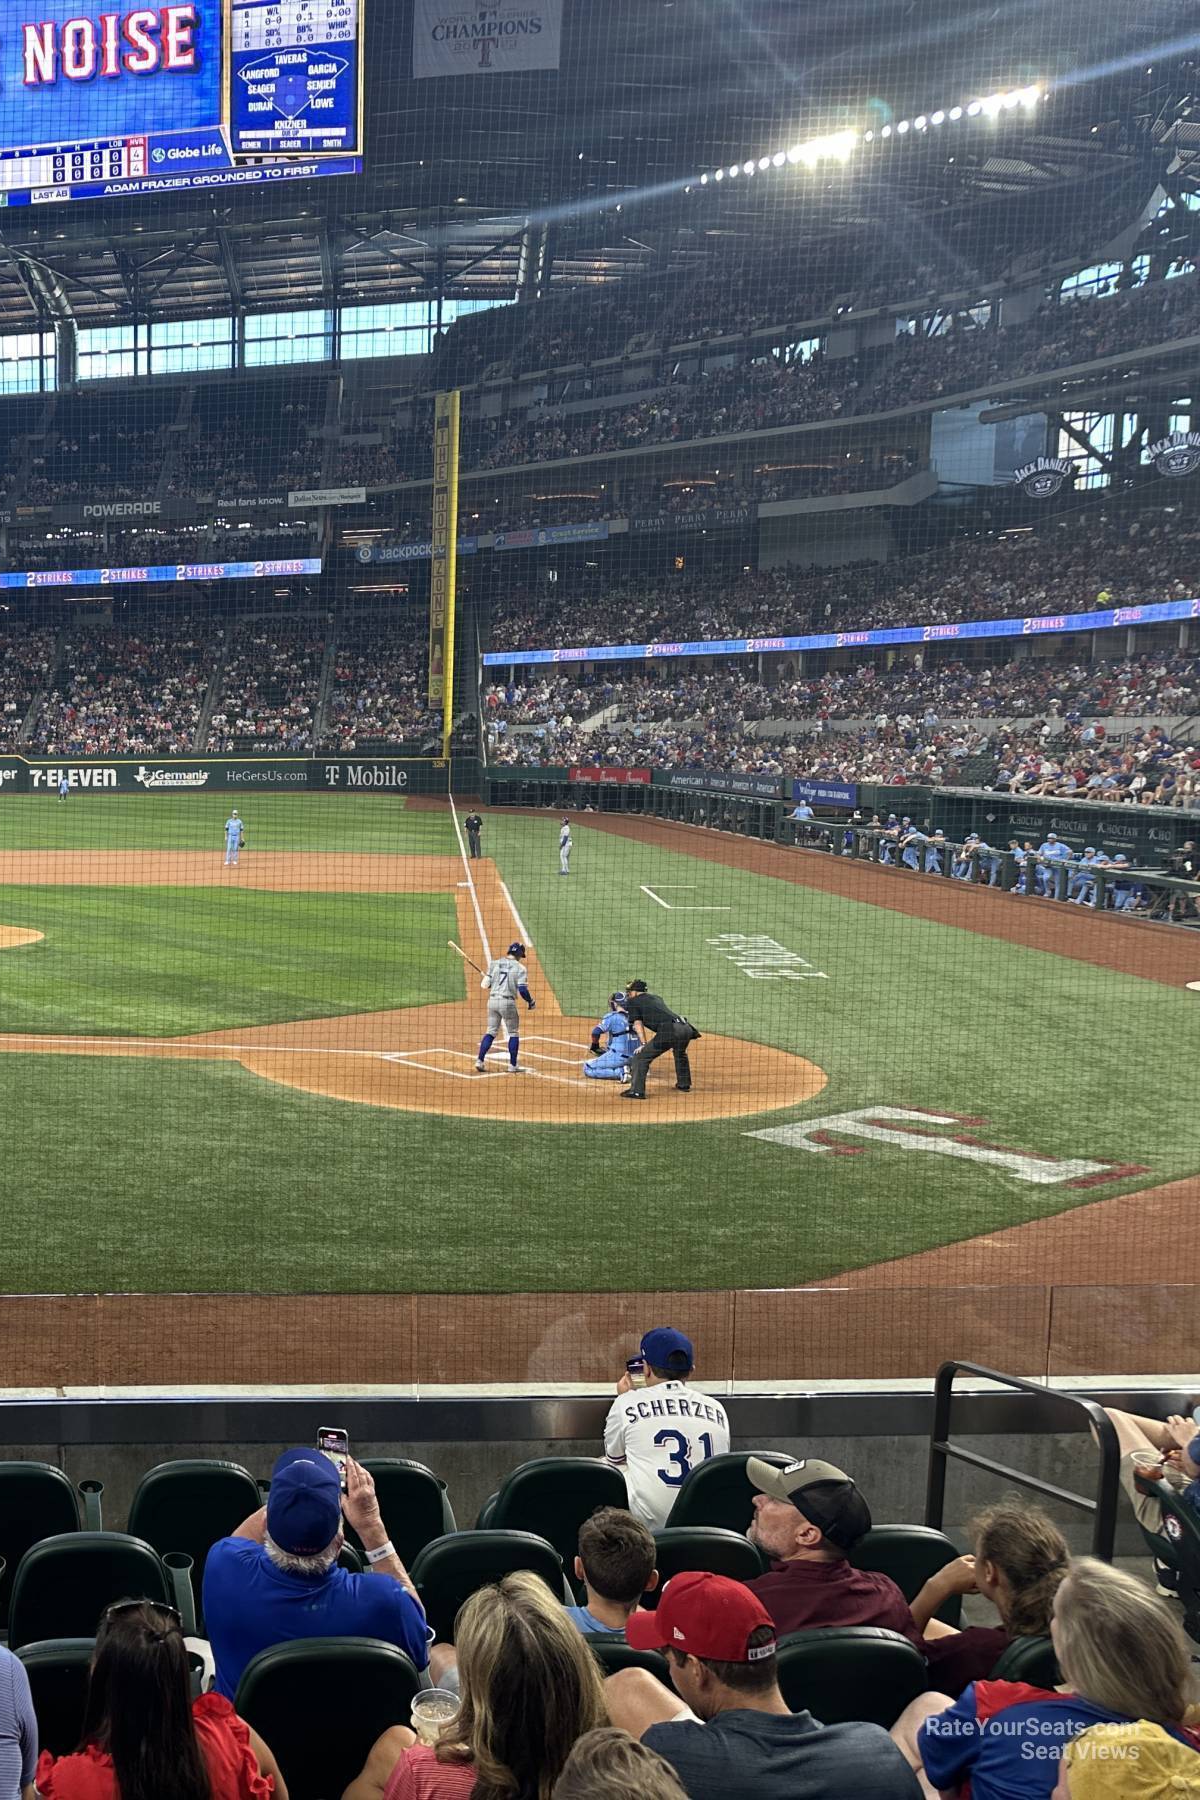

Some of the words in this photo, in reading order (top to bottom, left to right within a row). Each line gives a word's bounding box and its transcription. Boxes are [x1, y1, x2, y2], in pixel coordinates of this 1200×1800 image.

[328, 21, 347, 30] WHIP
[432, 17, 542, 41] CHAMPIONS
[22, 5, 195, 86] NOISE
[275, 53, 307, 65] TAVERAS
[242, 68, 279, 79] LANGFORD
[308, 63, 337, 75] GARCIA
[248, 83, 275, 94] SEAGER
[307, 79, 336, 90] SEMIEN
[248, 101, 272, 112] DURAN
[311, 98, 334, 109] LOWE
[274, 119, 307, 130] KNIZNER
[167, 147, 200, 159] Globe
[202, 144, 222, 156] Life
[104, 183, 139, 193] ADAM
[141, 178, 191, 190] FRAZIER
[192, 171, 262, 185] GROUNDED
[264, 169, 281, 178] TO
[283, 165, 318, 176] FIRST
[33, 191, 54, 200] LAST
[55, 189, 67, 198] AB
[437, 430, 448, 481] THE
[1146, 436, 1171, 461] JACK
[1013, 462, 1037, 484] JACK
[84, 501, 161, 517] POWERADE
[217, 499, 237, 507] Real
[238, 498, 256, 506] fans
[435, 496, 446, 545] HOT
[101, 569, 109, 583] 2
[110, 569, 147, 580] STRIKES
[176, 565, 185, 580] 2
[187, 565, 224, 577] STRIKES
[255, 561, 263, 576] 2
[265, 561, 303, 573] STRIKES
[27, 572, 35, 587] 2
[36, 572, 72, 583] STRIKES
[433, 562, 444, 627] ZONE
[923, 627, 930, 640] 2
[1023, 618, 1031, 634] 2
[647, 644, 653, 657] 2
[154, 770, 208, 781] Germania
[226, 770, 308, 782] HeGetsUs.com
[347, 766, 407, 786] Mobile
[671, 776, 703, 786] American
[500, 971, 508, 986] 7
[625, 1399, 726, 1426] SCHERZER
[653, 1429, 714, 1488] 31
